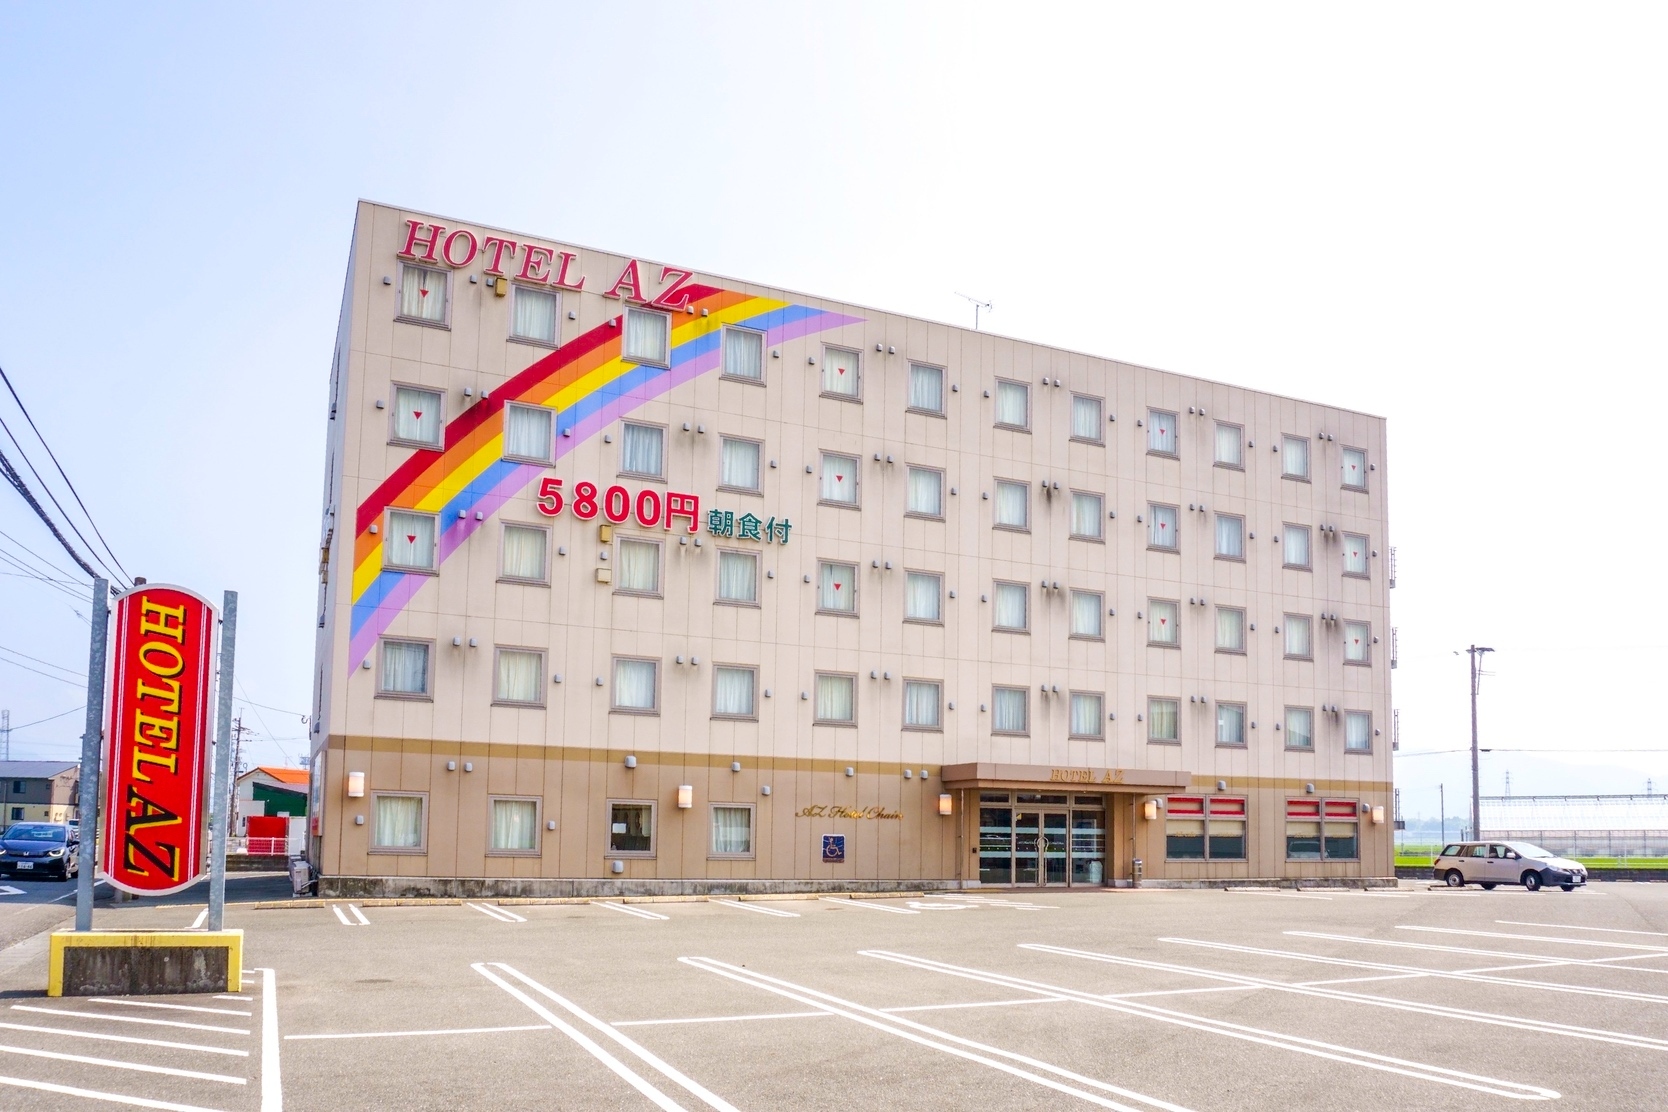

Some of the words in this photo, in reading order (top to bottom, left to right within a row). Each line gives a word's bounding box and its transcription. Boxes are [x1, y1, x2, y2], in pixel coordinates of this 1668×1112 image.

[397, 219, 586, 292] HOTEL
[602, 258, 694, 312] AZ
[536, 477, 700, 533] 5800円
[707, 508, 793, 545] 朝食付
[131, 596, 187, 787] HOTEL
[795, 804, 828, 818] AZ
[828, 805, 868, 819] Hotel
[866, 805, 904, 820] Chain
[1050, 767, 1096, 783] HOTEL
[1101, 768, 1124, 784] AZ
[122, 783, 183, 882] AZ
